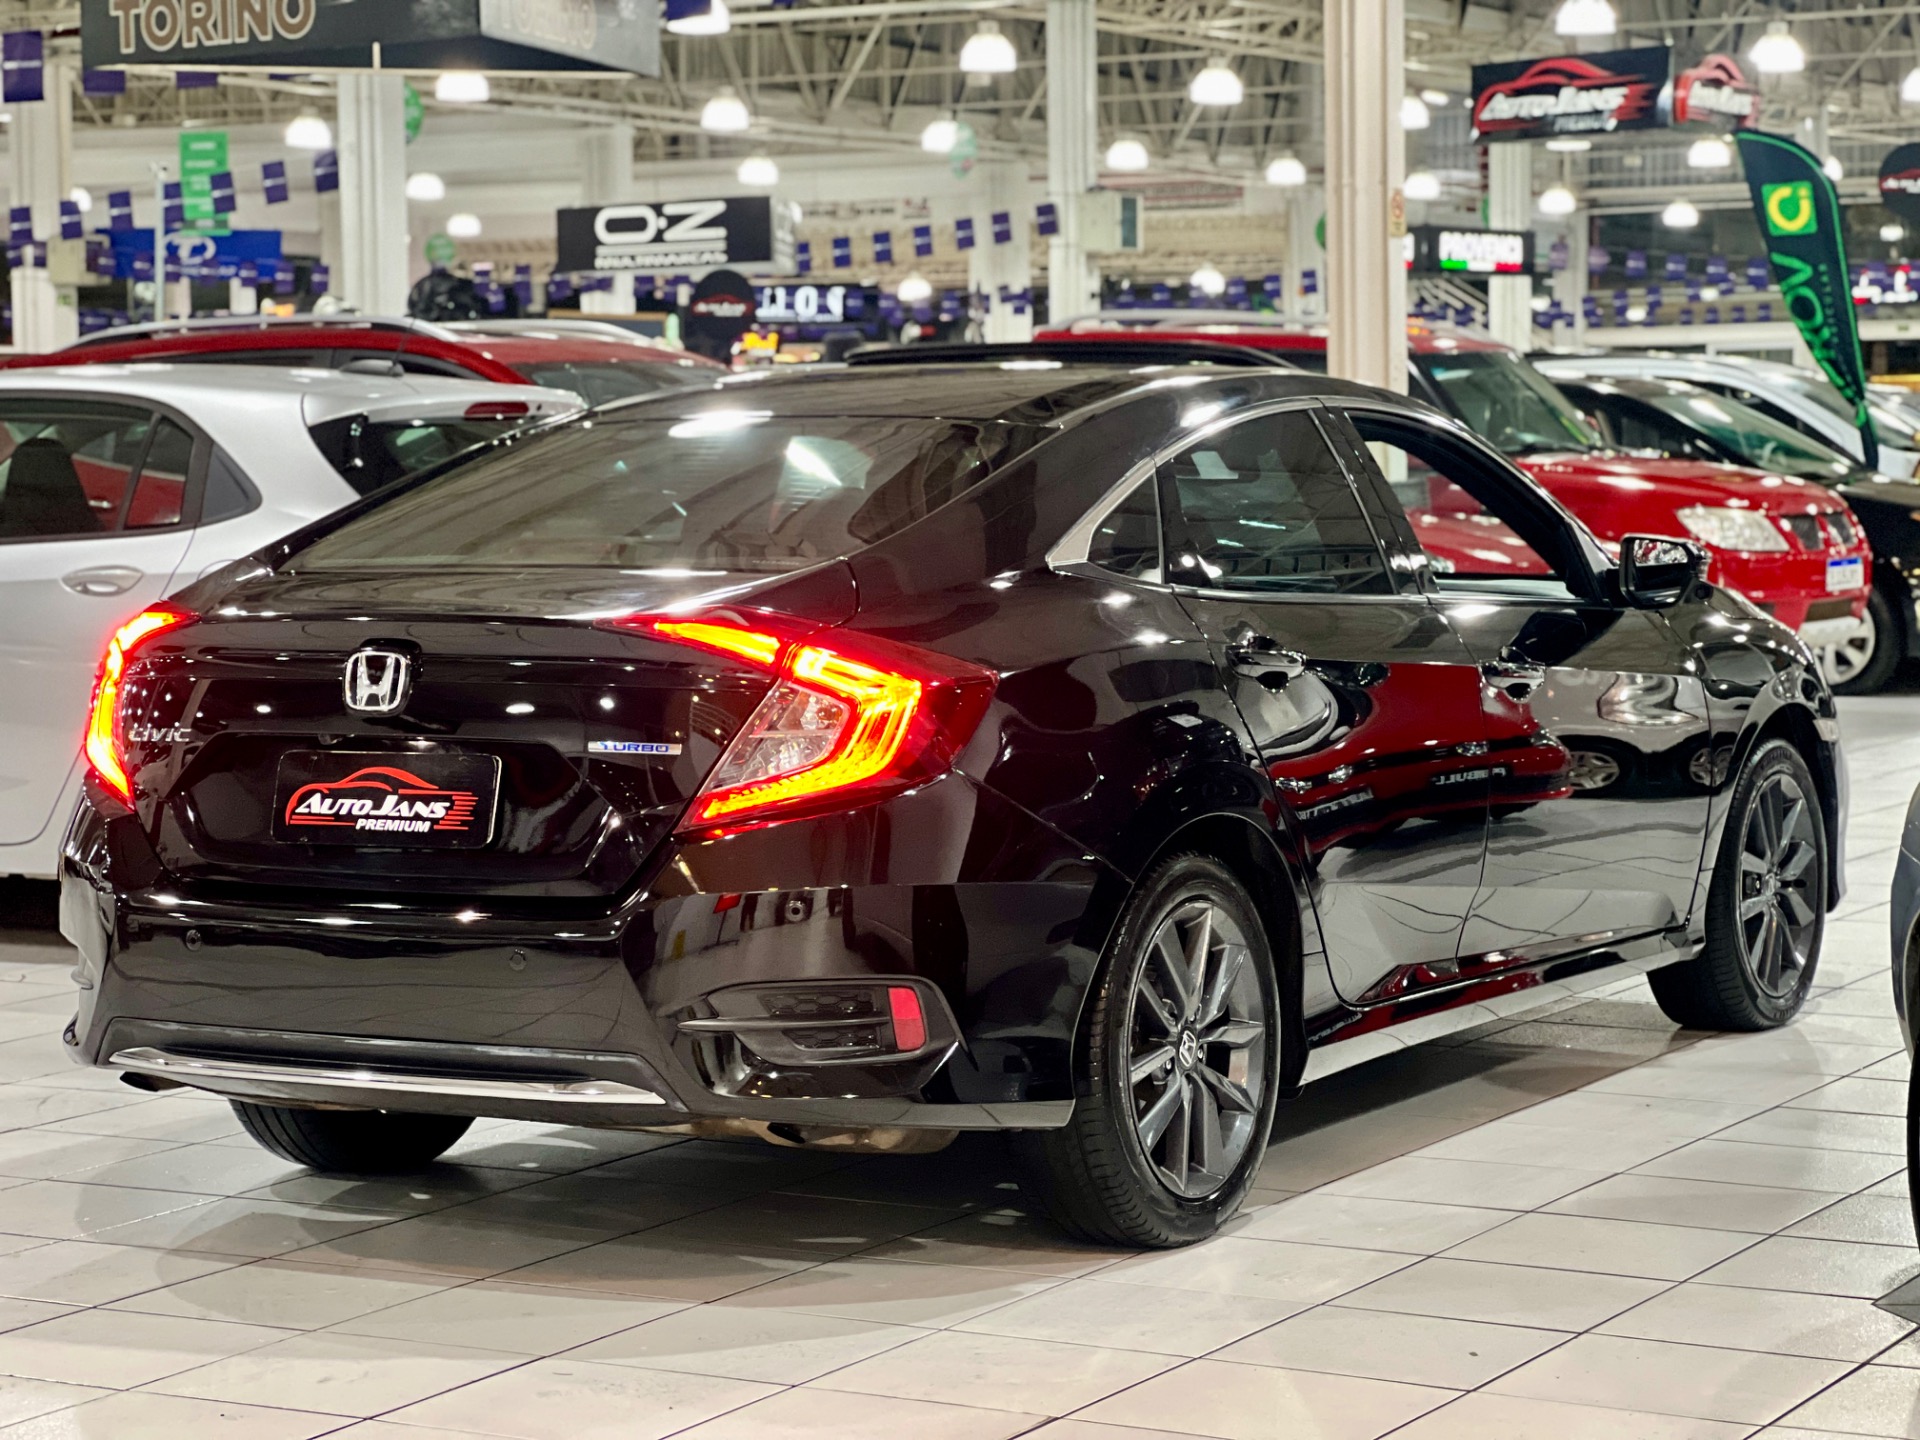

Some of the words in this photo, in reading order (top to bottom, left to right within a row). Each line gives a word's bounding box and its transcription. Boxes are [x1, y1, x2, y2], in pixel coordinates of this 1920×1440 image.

[109, 0, 316, 53] TORINO
[600, 741, 669, 753] TURBO
[355, 818, 431, 833] PREMIUM
